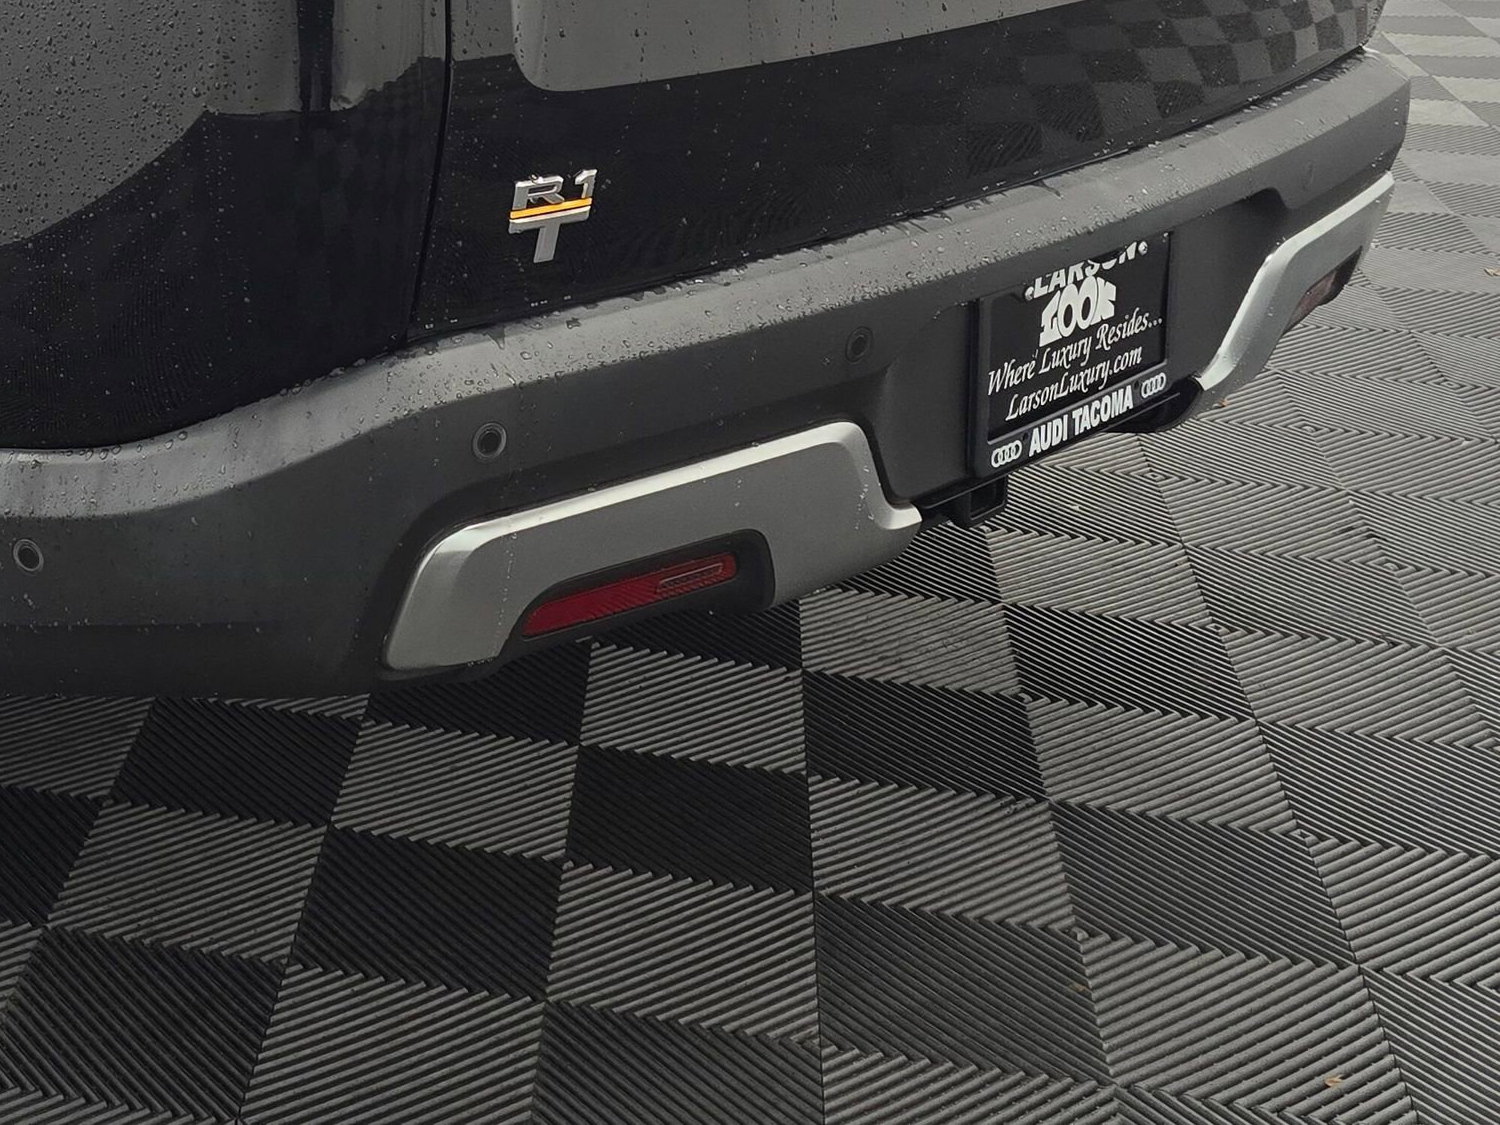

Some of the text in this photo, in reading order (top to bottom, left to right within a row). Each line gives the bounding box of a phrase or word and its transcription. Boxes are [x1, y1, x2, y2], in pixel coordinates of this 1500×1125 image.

[988, 307, 1163, 396] Where Luxury Resides...
[1005, 346, 1143, 421] LarsonLuxury.com
[1028, 385, 1134, 457] AUDI TACOMA
